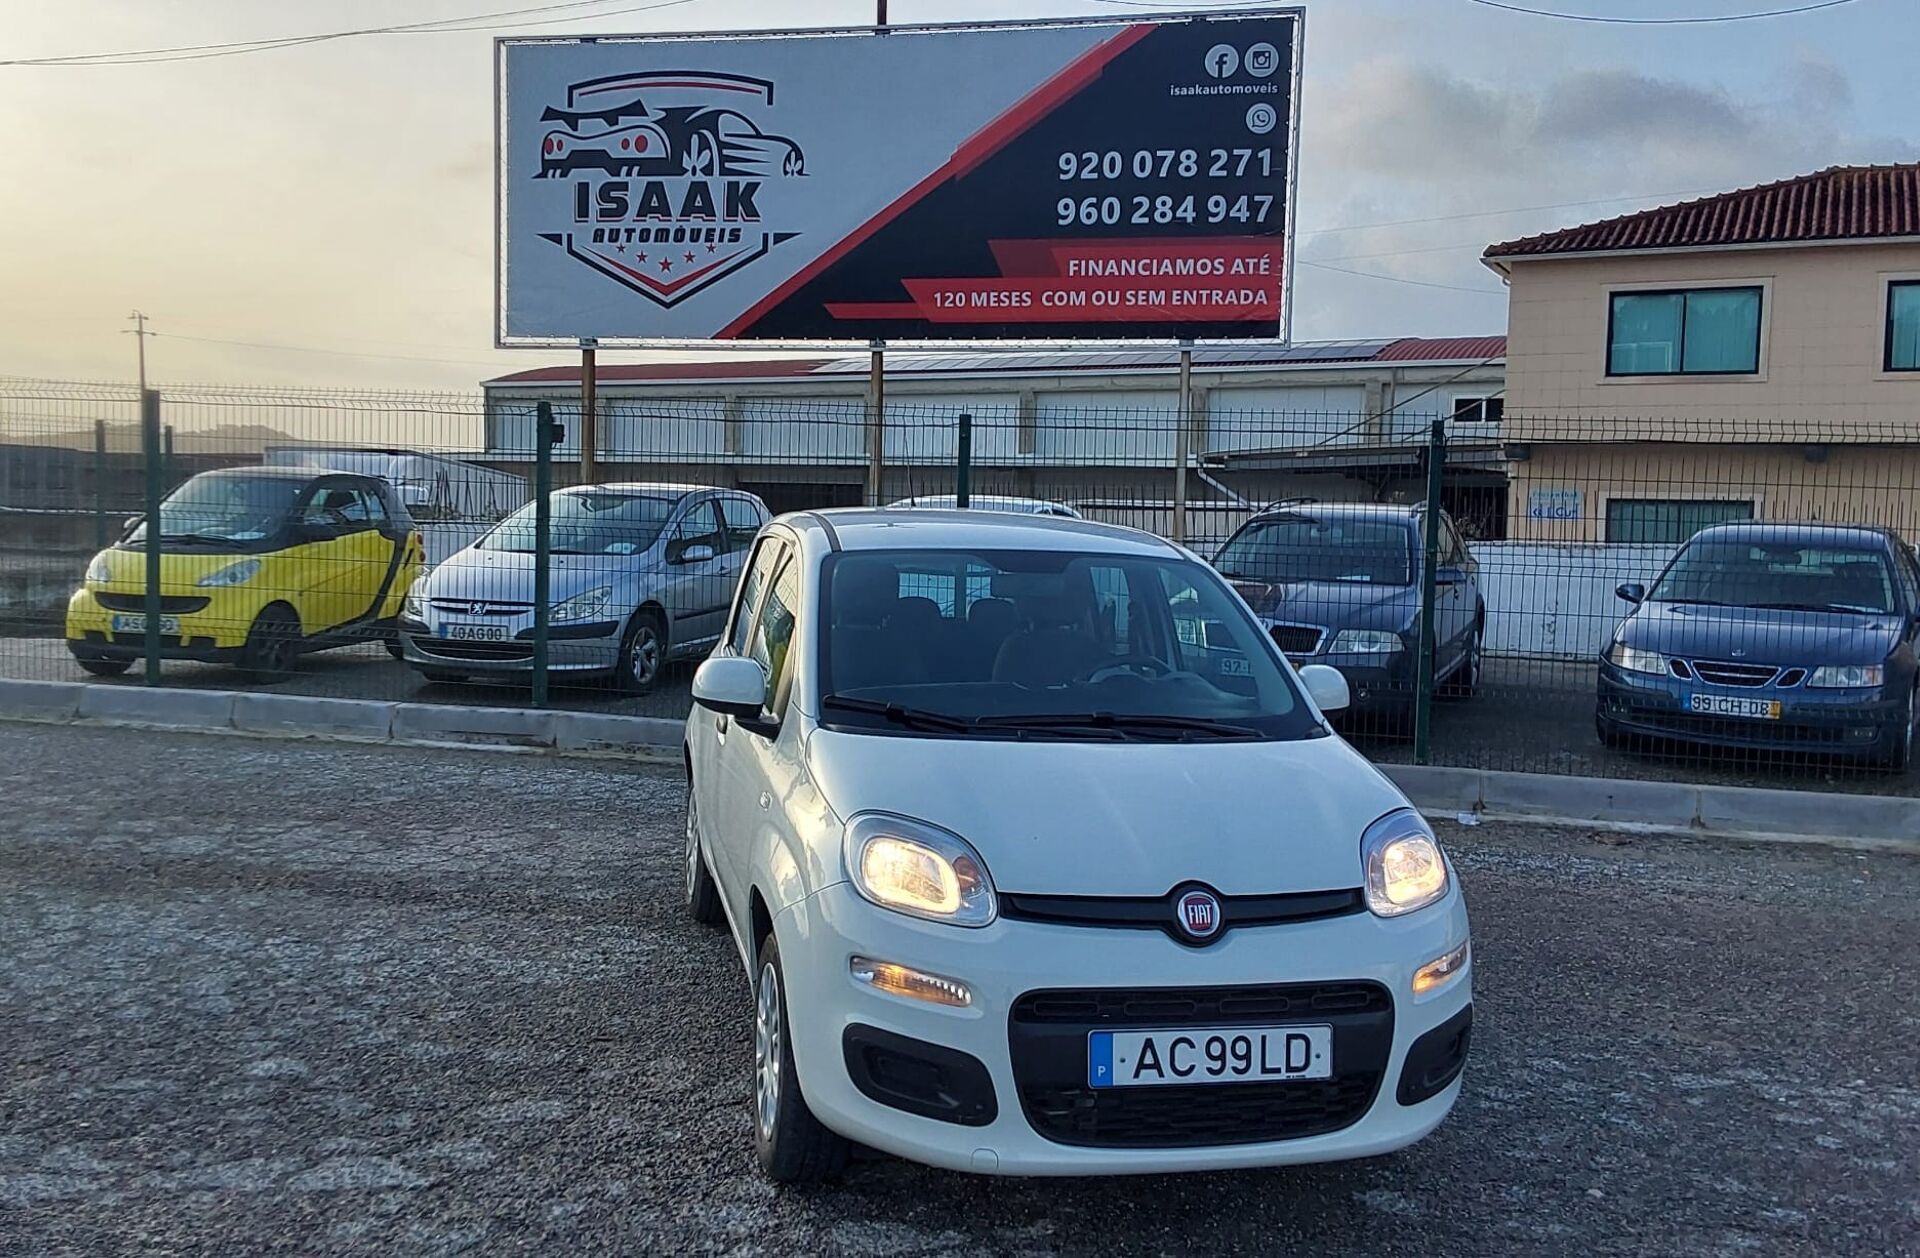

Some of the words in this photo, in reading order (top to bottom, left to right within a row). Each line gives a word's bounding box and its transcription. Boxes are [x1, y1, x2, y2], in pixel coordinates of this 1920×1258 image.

[1170, 82, 1278, 96] isaakautomoveis
[1058, 151, 1123, 180] 920
[1132, 149, 1198, 178] 078
[1209, 148, 1272, 177] 271
[574, 180, 762, 223] ISAAK
[1057, 197, 1121, 226] 960
[1131, 195, 1197, 224] 284
[1207, 195, 1274, 224] 947
[1068, 258, 1225, 277] FINANCIAMOS
[1230, 253, 1271, 275] ATÉ
[933, 292, 966, 308] 120
[971, 291, 1032, 307] MESES
[1041, 290, 1087, 307] COM
[1091, 290, 1121, 306] OU
[1125, 290, 1166, 306] SEM
[1172, 289, 1269, 305] ENTRADA
[1187, 904, 1212, 925] FIAT
[1097, 1065, 1106, 1077] P
